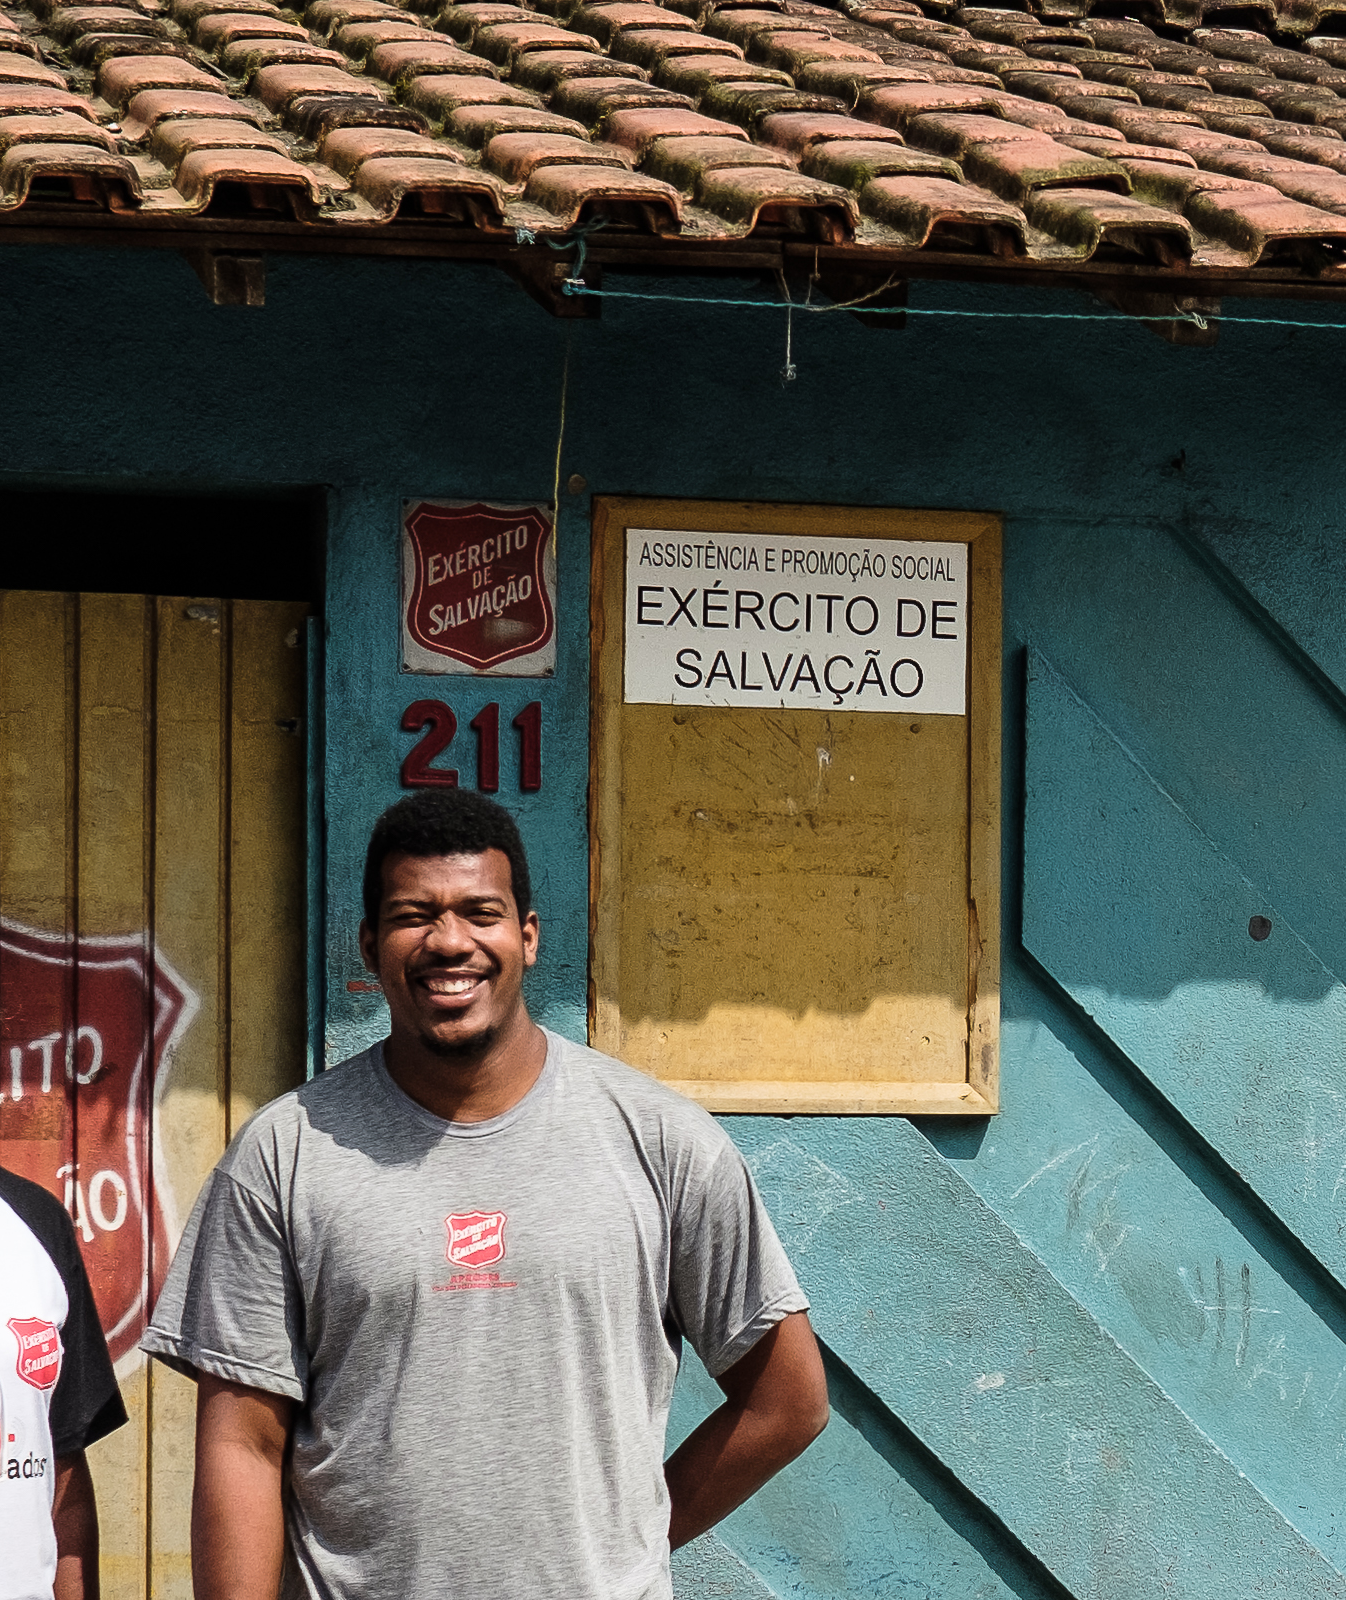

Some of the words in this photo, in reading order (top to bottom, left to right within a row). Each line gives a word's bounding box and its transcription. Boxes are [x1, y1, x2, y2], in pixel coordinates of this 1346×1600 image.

[427, 525, 529, 587] EXÉRCITO
[472, 565, 494, 590] DE
[639, 540, 760, 572] ASSISTÊNCIA
[765, 548, 776, 573] E
[781, 549, 887, 583] PROMOÇÃO
[891, 553, 956, 582] SOCIAL
[428, 573, 533, 637] SALVAÇÃO
[636, 580, 880, 637] EXÉRCITO
[896, 597, 958, 640] DE
[674, 648, 924, 705] SALVAÇÃO
[401, 699, 542, 793] 211
